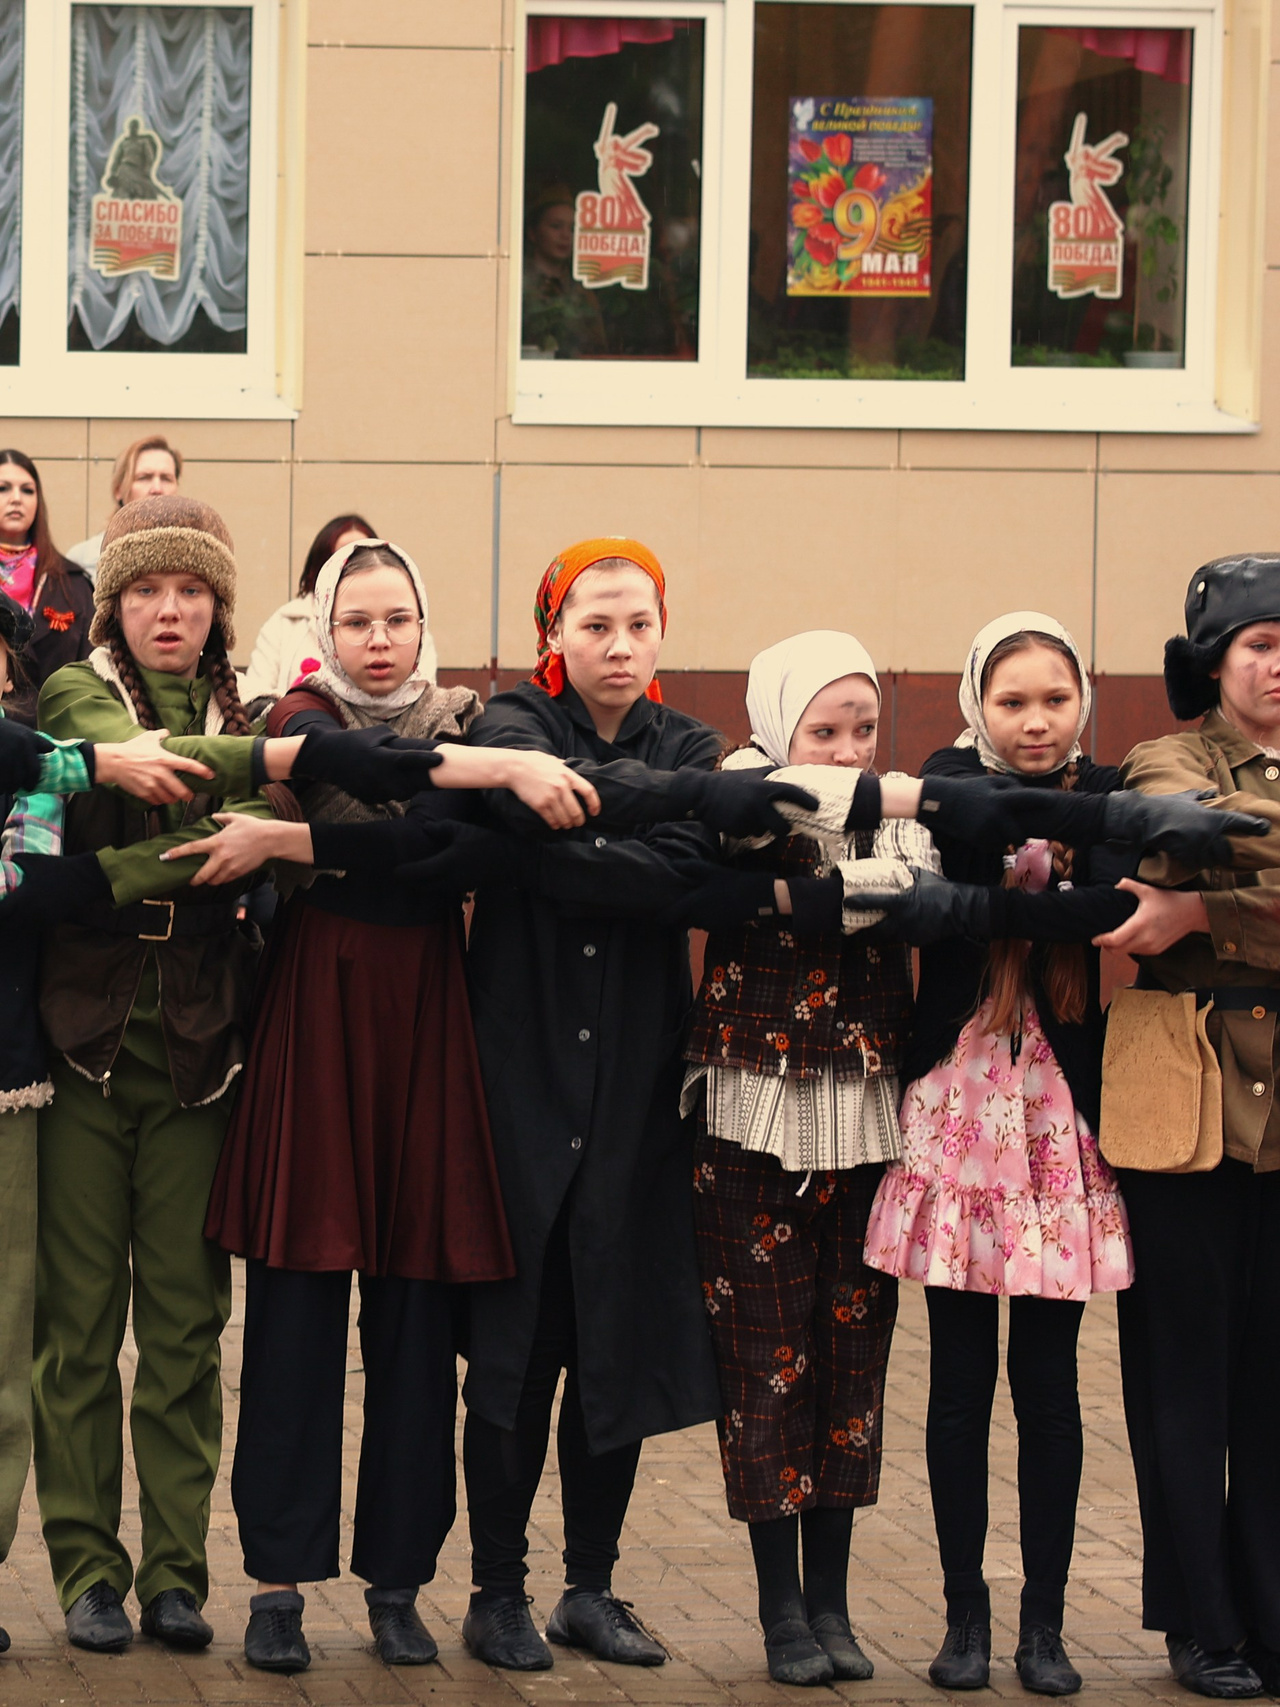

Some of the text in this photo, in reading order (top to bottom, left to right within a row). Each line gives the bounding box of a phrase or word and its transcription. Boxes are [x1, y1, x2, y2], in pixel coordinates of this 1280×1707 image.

[95, 201, 179, 224] СПАСИБО
[580, 195, 616, 230] 80
[1053, 206, 1088, 239] 80
[95, 224, 177, 242] ЗА ПОБЕДУ!
[833, 188, 880, 260] 9
[578, 235, 646, 256] ПОБЕДА!
[1053, 245, 1118, 266] ПОБЕДА!
[861, 252, 919, 274] МАЯ
